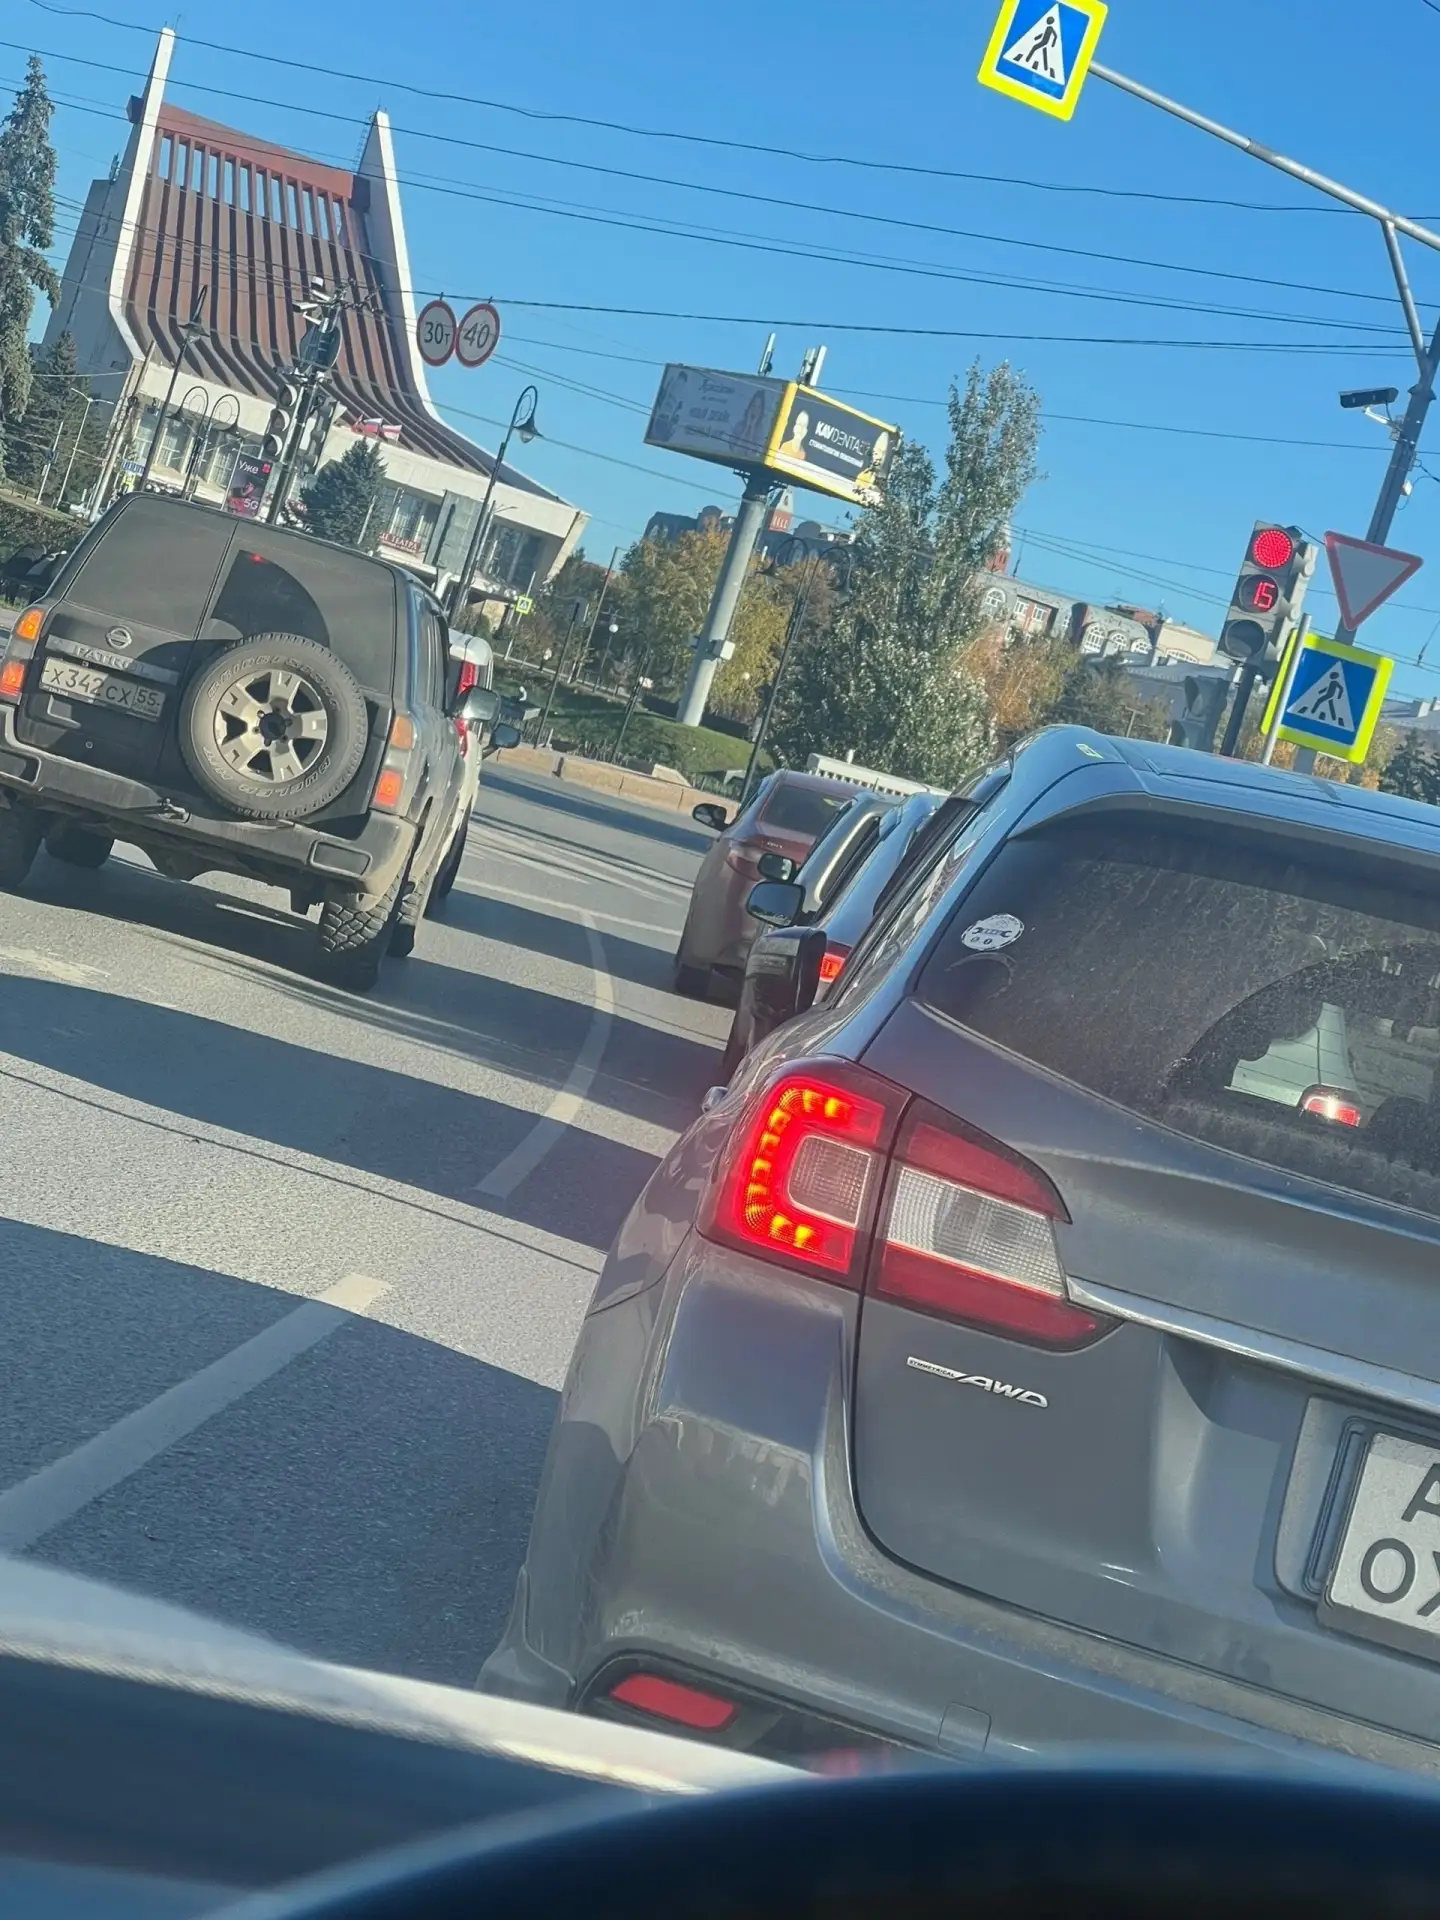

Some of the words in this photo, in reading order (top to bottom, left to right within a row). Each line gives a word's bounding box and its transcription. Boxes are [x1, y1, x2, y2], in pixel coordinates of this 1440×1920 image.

[463, 322, 490, 349] 40
[239, 459, 259, 474] Уже
[243, 498, 259, 510] 5G
[1253, 581, 1276, 609] 15
[908, 1359, 956, 1378] SYMMETRICAL
[957, 1375, 1048, 1409] AWD
